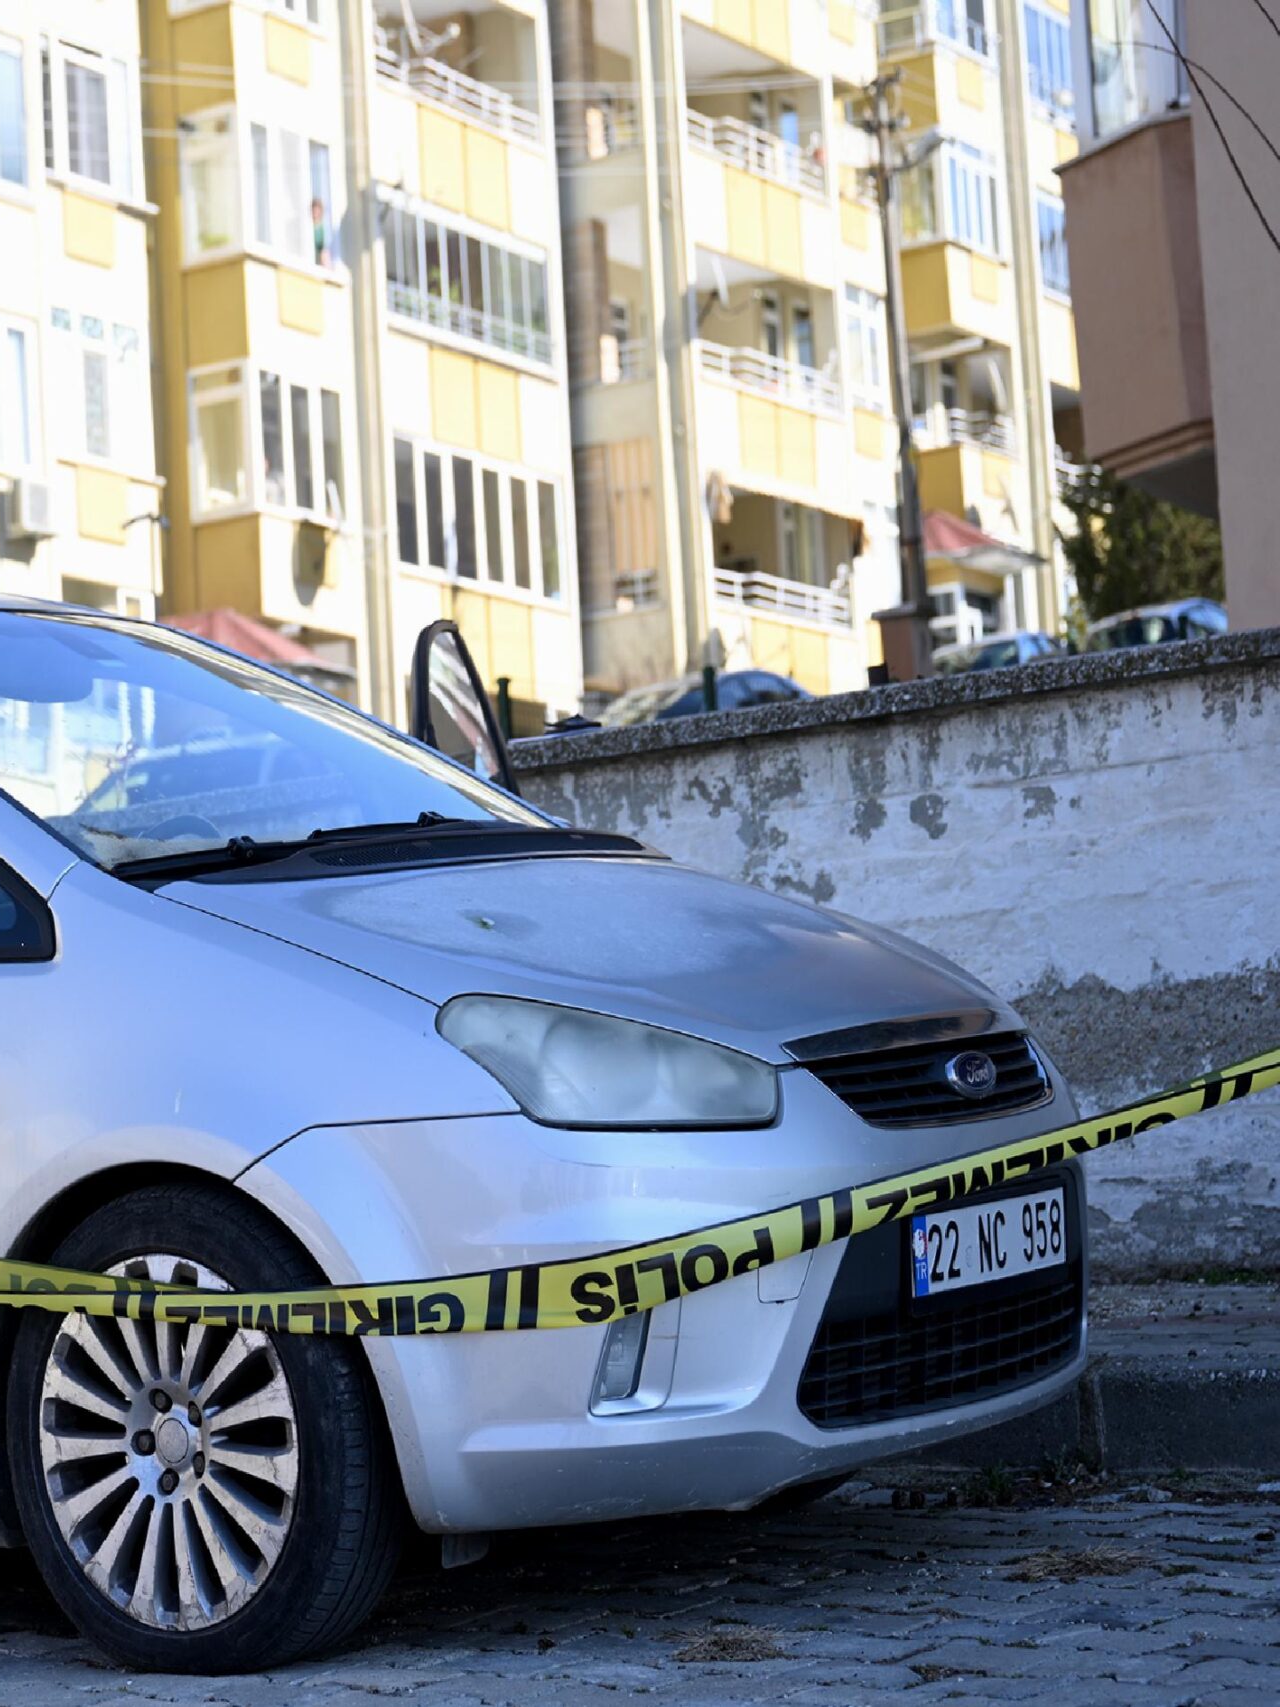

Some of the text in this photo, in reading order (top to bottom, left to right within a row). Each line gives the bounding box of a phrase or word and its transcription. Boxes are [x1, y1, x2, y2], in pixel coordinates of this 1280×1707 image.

[966, 1060, 990, 1084] Ford
[569, 1225, 775, 1325] POLİS
[927, 1198, 1062, 1284] 22 NC 958
